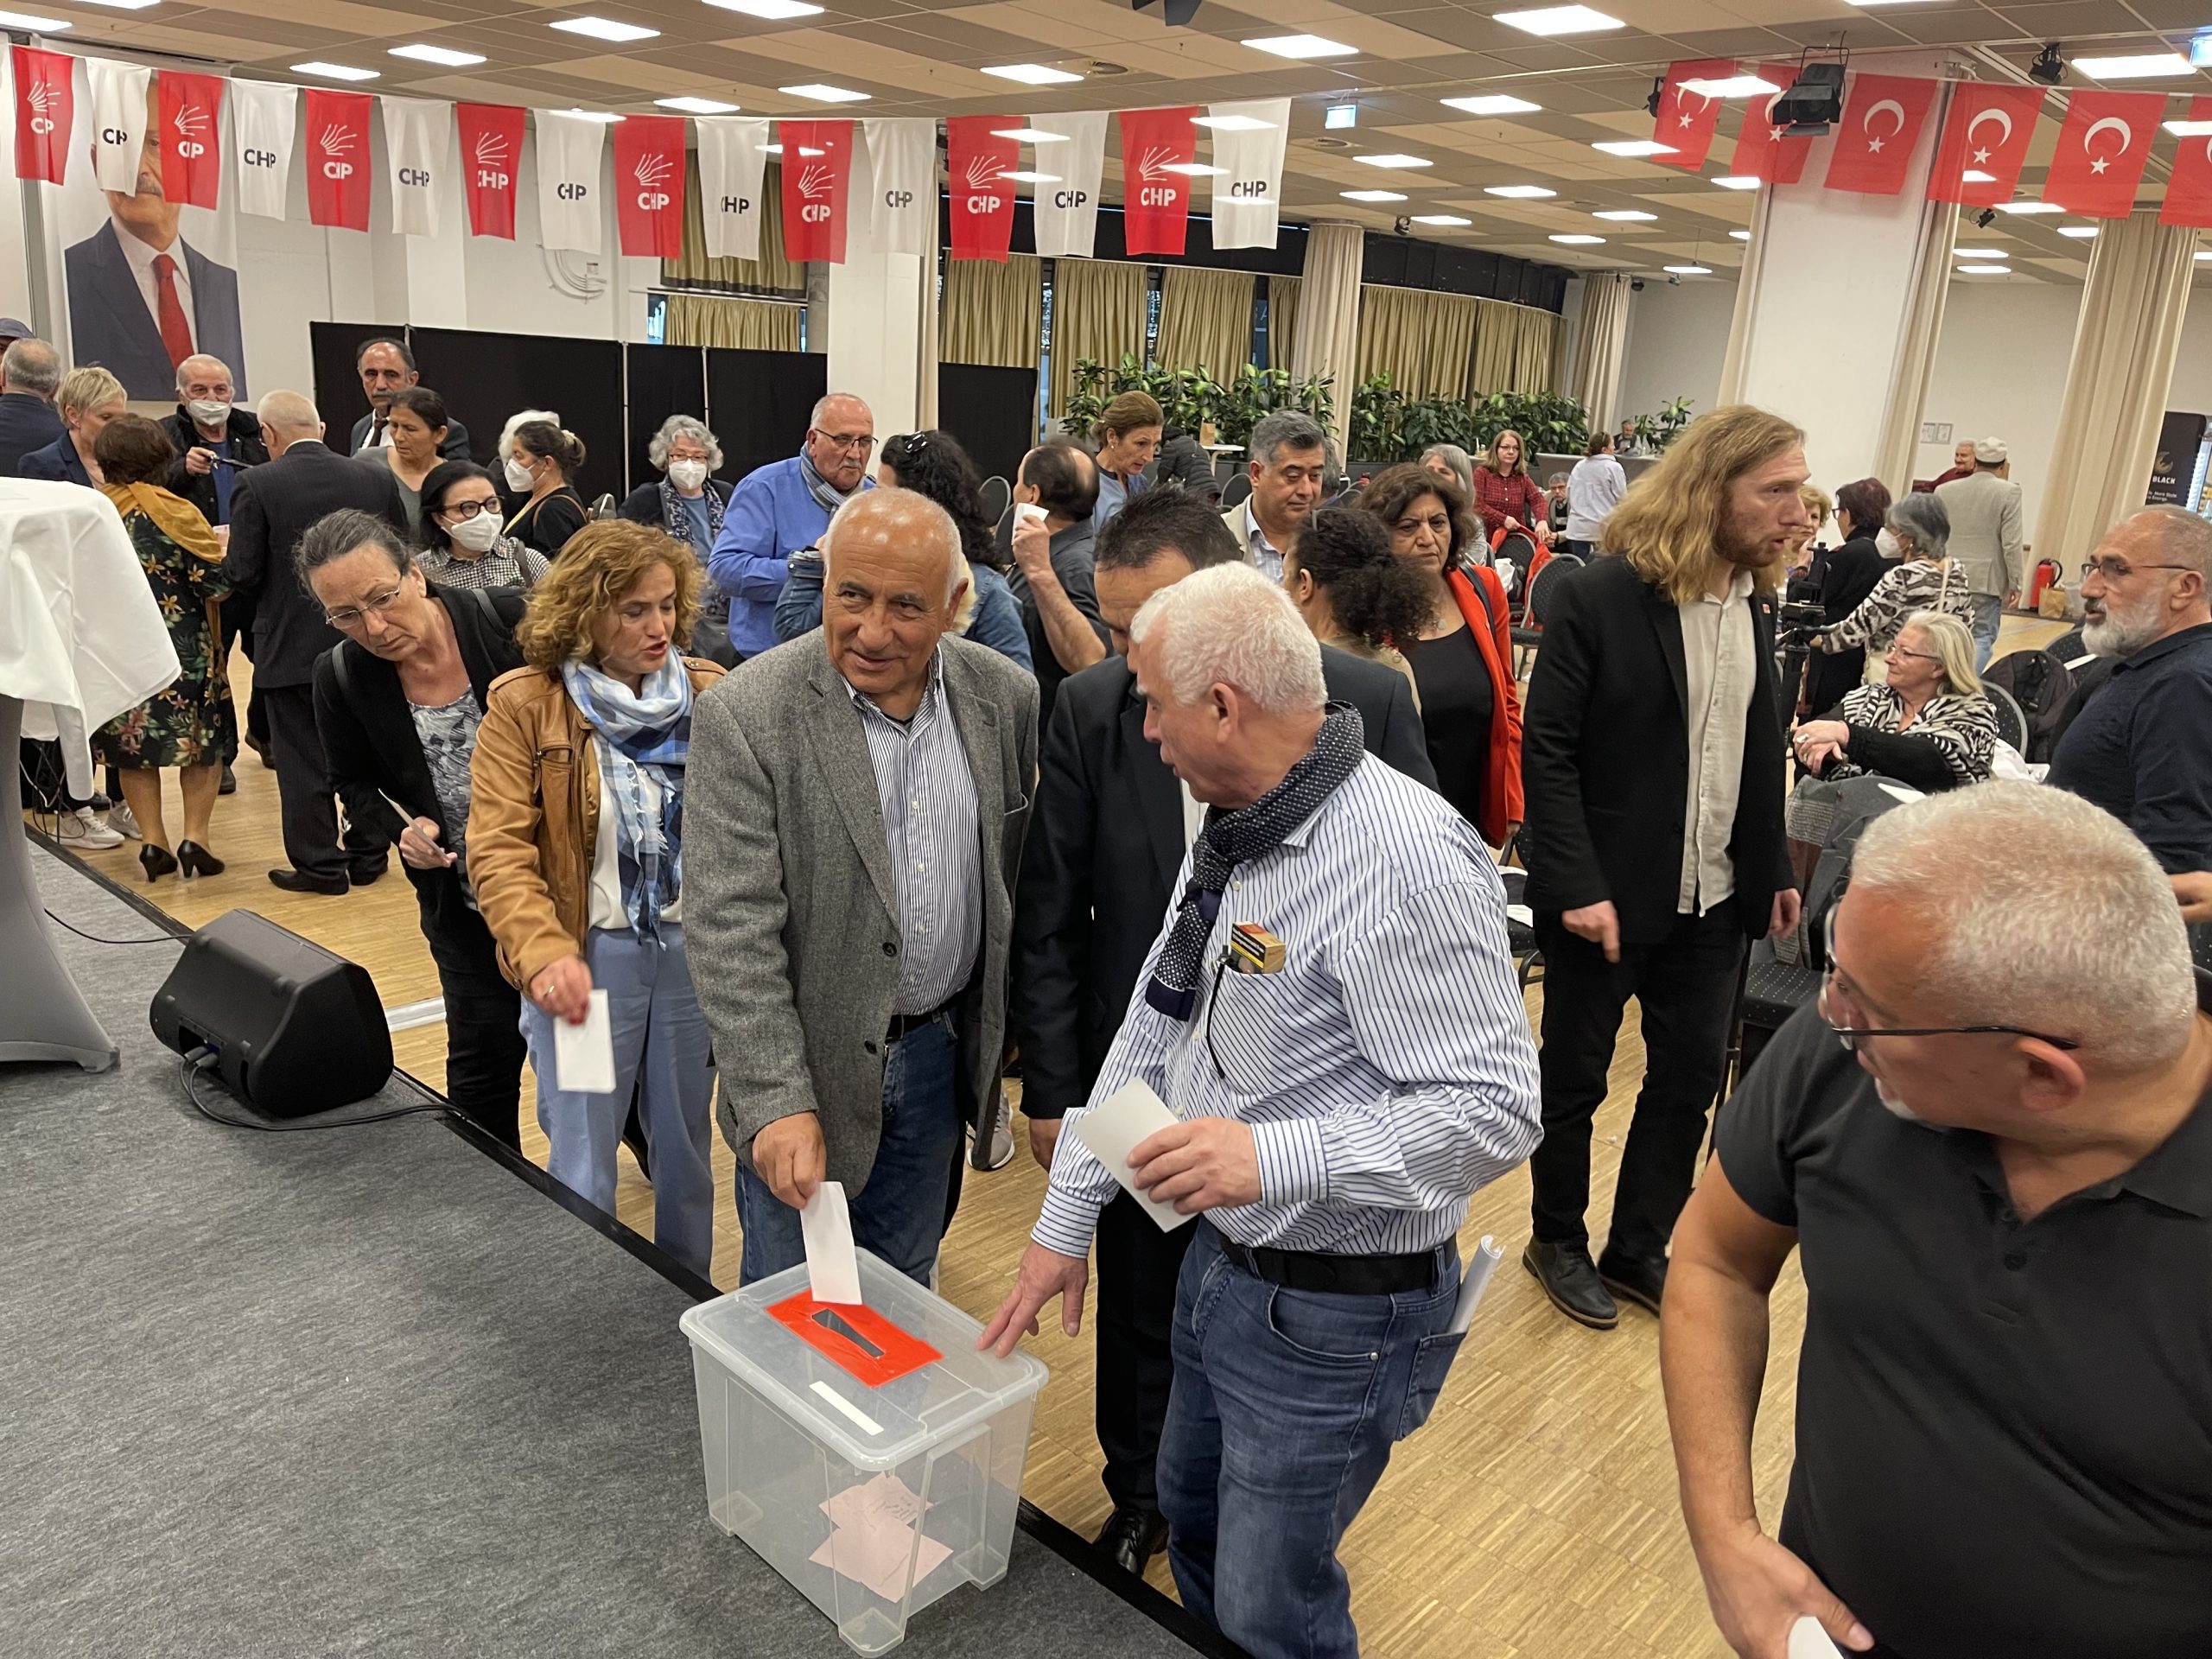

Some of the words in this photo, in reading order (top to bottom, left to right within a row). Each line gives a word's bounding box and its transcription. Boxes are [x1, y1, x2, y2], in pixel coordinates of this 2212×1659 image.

[30, 117, 54, 135] CP
[178, 141, 204, 159] CP
[244, 149, 276, 168] CHP
[398, 168, 429, 188] CHP
[557, 183, 587, 200] CHP
[886, 190, 913, 208] CHP
[1141, 188, 1176, 207] CHP
[1231, 181, 1268, 198] CHP
[637, 192, 670, 211] CHP
[721, 195, 750, 214] HP
[967, 195, 1001, 214] CHP
[1055, 191, 1087, 208] CHP
[802, 204, 831, 223] CHP
